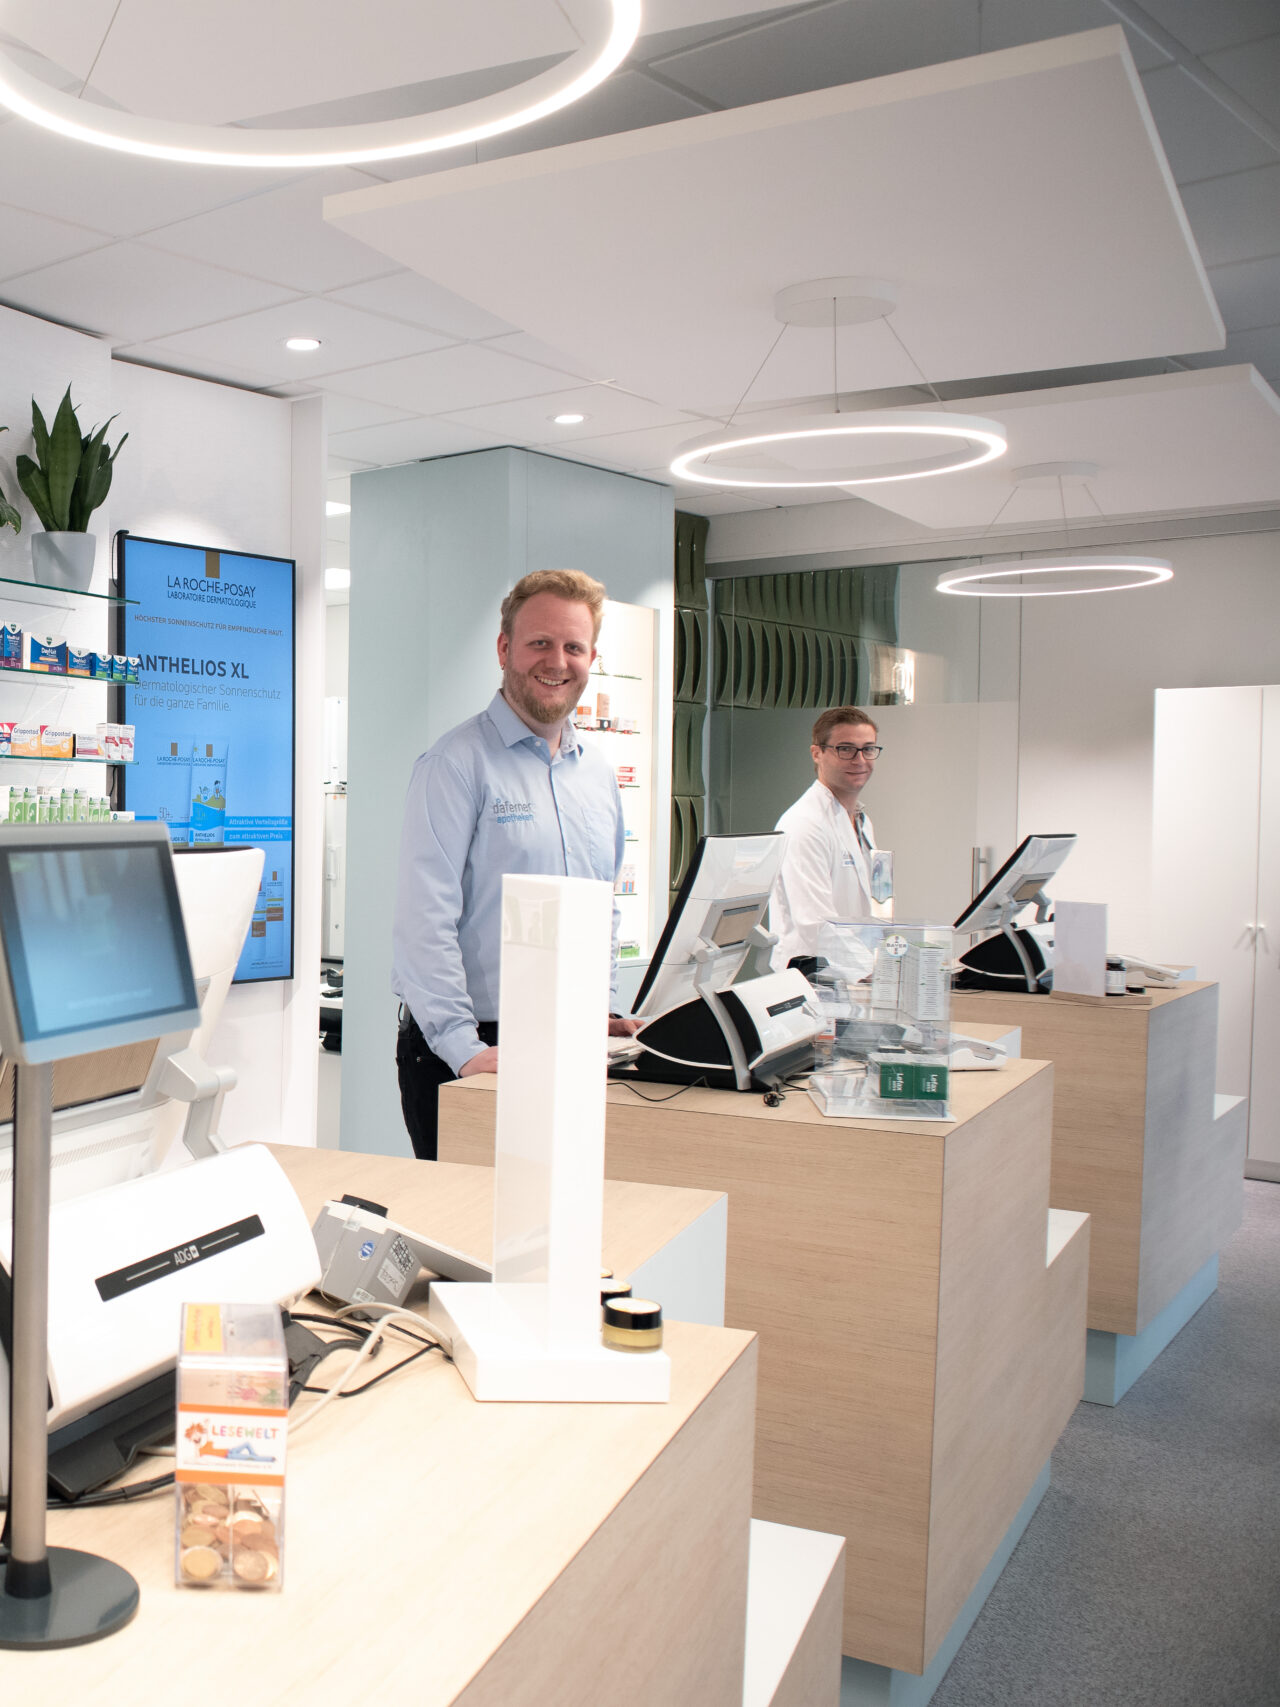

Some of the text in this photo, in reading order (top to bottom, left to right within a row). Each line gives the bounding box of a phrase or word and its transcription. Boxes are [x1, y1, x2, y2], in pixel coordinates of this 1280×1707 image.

[167, 575, 257, 598] LA ROCHE-POSAY
[167, 590, 257, 609] LABORATOIRE DERMATOLOGIQUE
[167, 618, 214, 630] SONNENSCHUTZ
[137, 654, 250, 680] ANTHELIOS XL
[134, 679, 281, 700] Dermatologischer Sonnenschutz
[134, 694, 233, 712] für die ganze Familie.
[173, 1247, 194, 1267] ADG
[211, 1425, 279, 1440] LESEWELT
